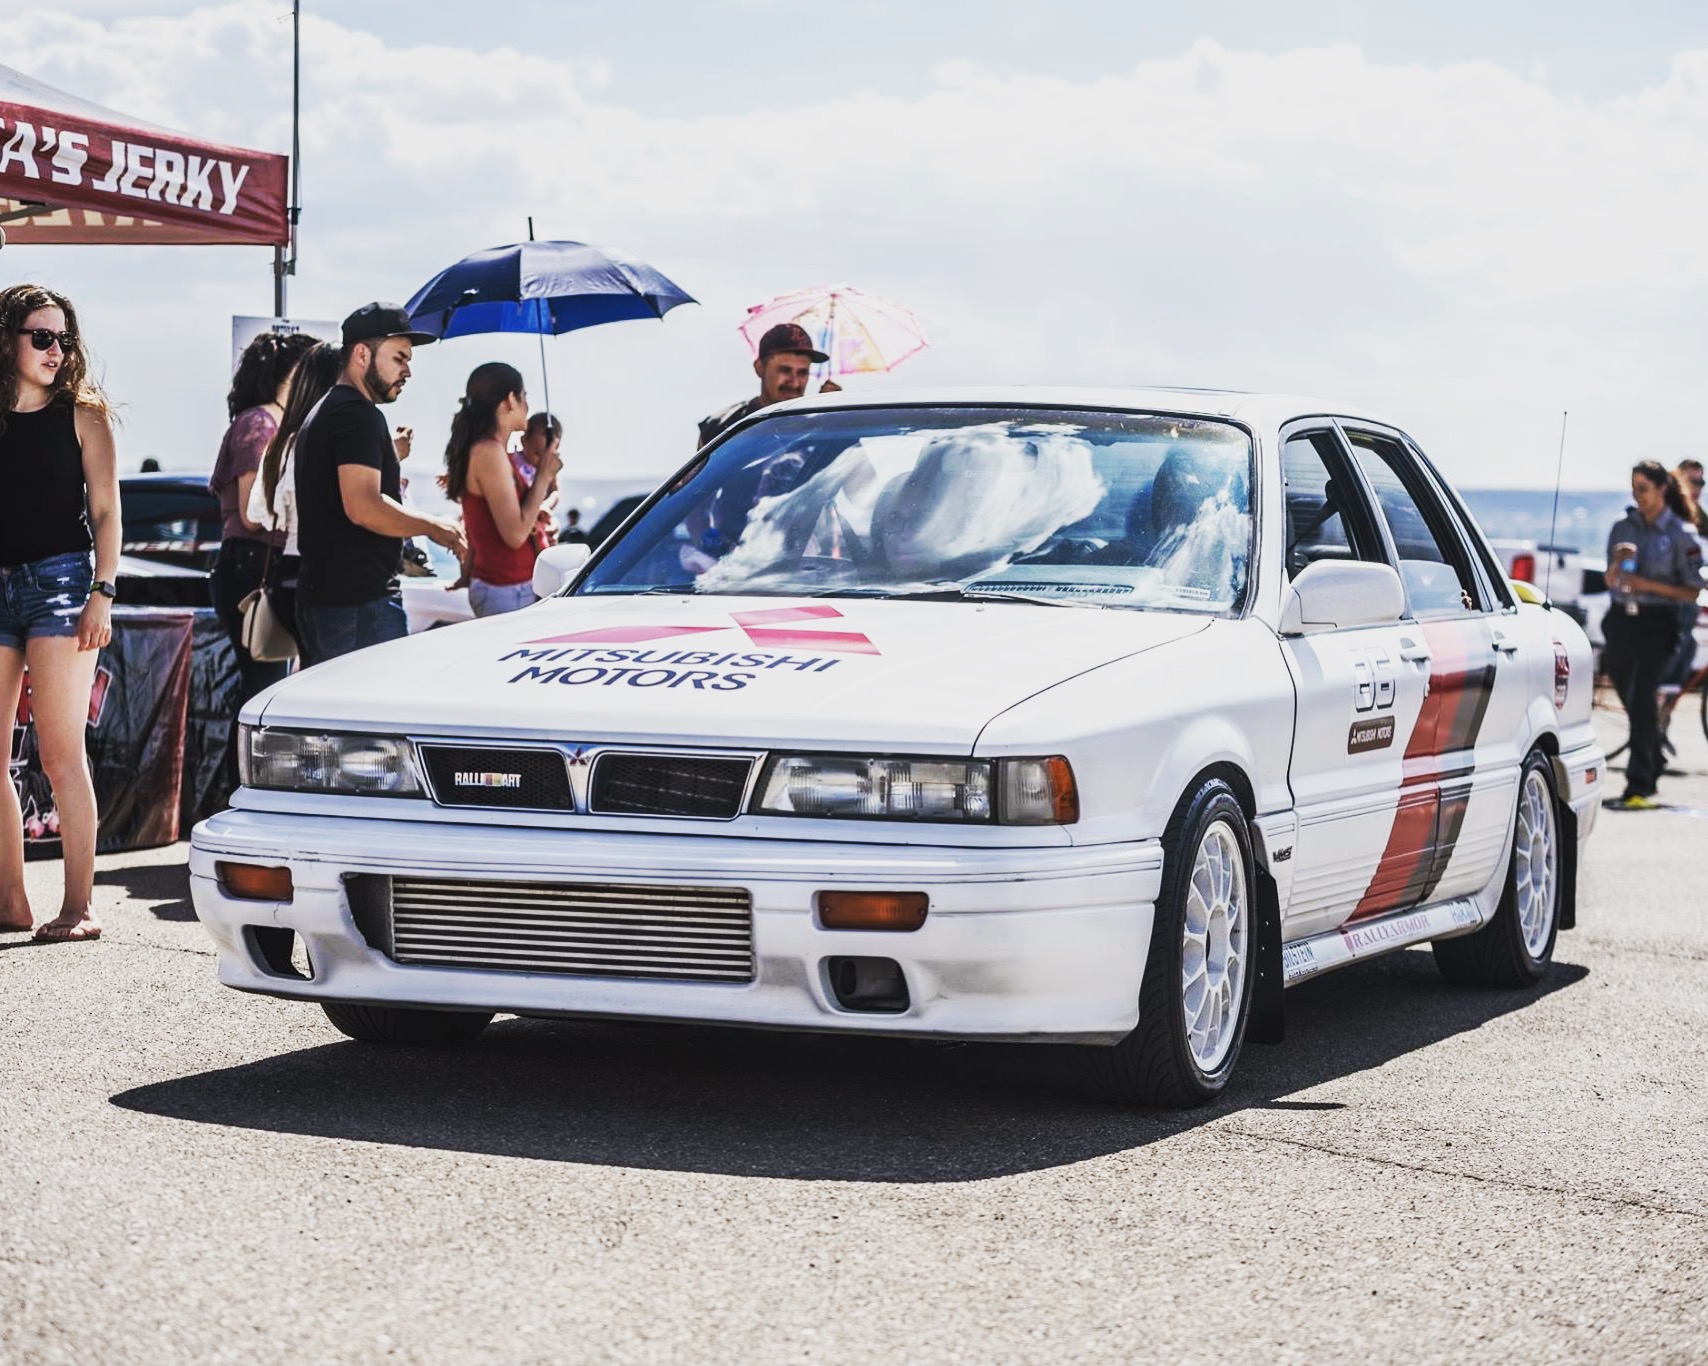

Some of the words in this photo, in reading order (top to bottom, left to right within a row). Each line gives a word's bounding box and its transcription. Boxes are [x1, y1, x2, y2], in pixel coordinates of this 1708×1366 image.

[0, 118, 90, 186] A'S
[92, 140, 250, 215] JERKY
[497, 648, 842, 673] MITSUBISHI
[507, 667, 756, 691] MOTORS
[454, 771, 521, 788] RALLIART
